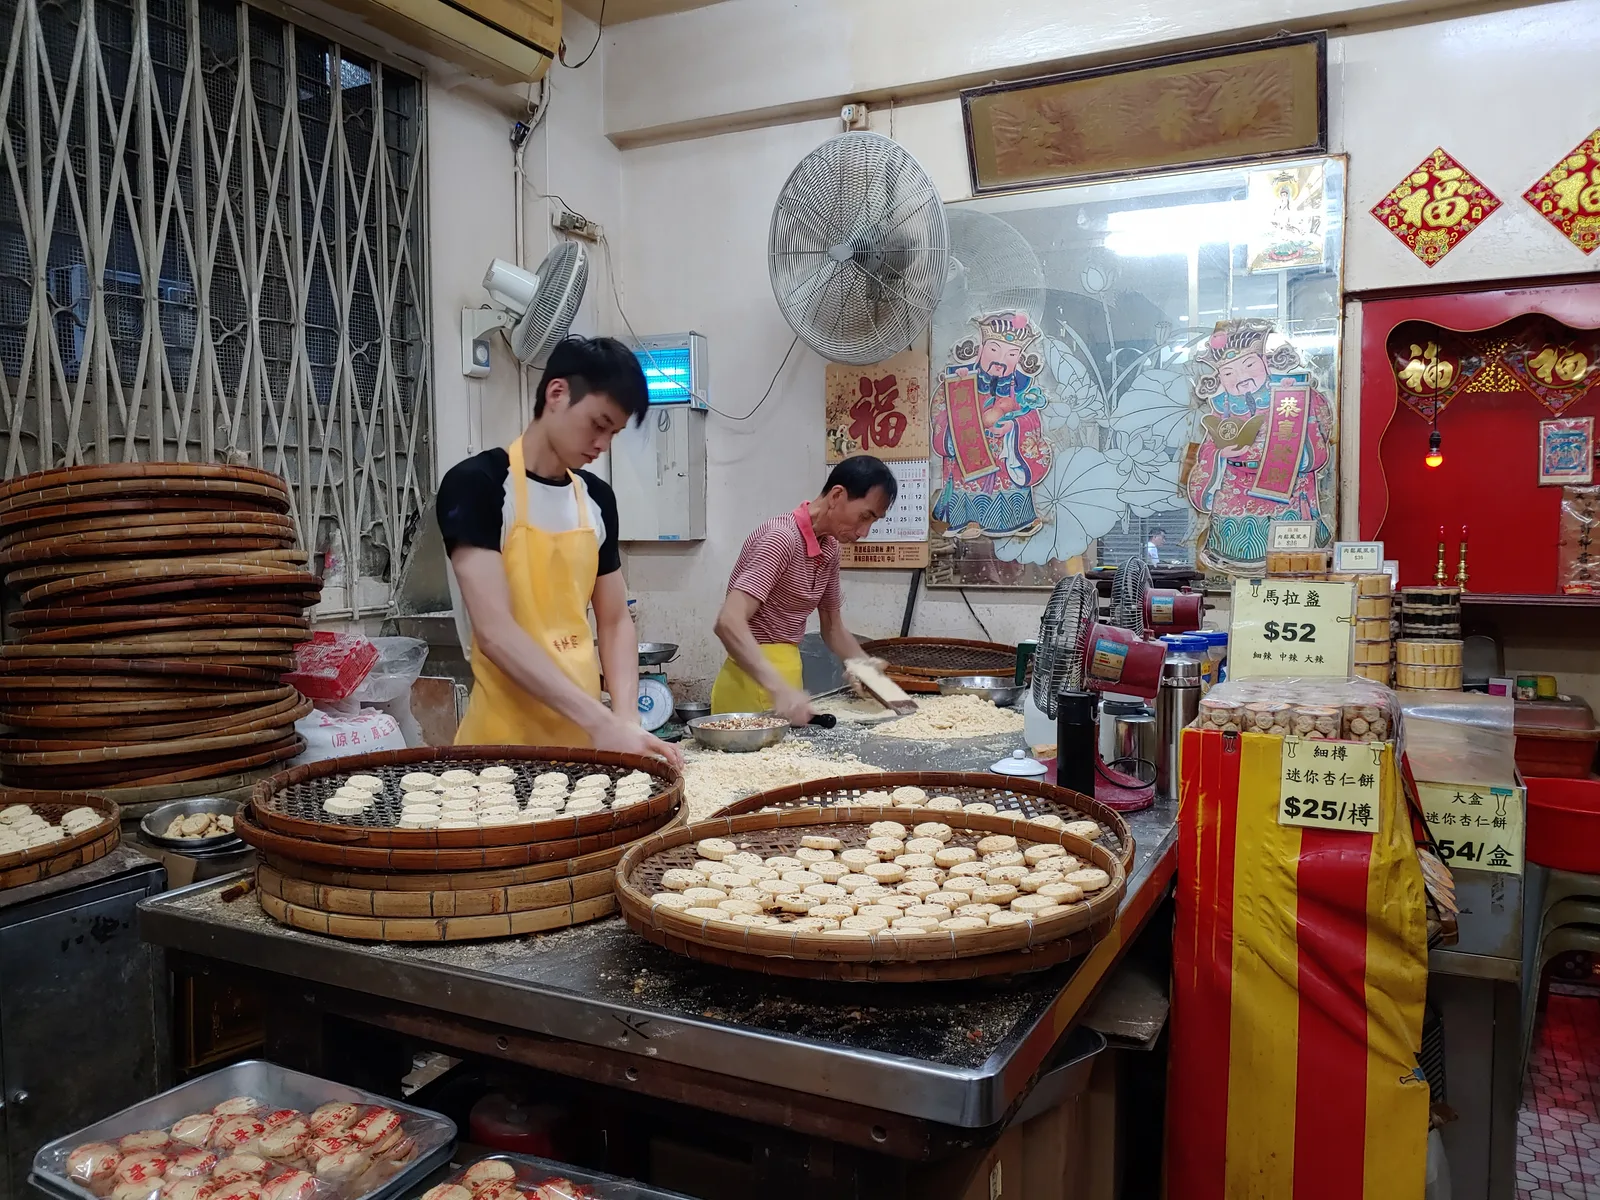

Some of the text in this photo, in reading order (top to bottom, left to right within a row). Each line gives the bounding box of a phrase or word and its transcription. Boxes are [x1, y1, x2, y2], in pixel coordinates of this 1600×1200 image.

[1398, 166, 1470, 228] 福
[1398, 341, 1454, 392] 福
[849, 374, 908, 451] 福
[1265, 396, 1302, 487] 恭喜發財
[1263, 589, 1321, 608] 馬拉盞
[1263, 620, 1316, 643] $52
[1252, 651, 1325, 664] 細辣 中辣 大辣
[1313, 745, 1349, 762] 細樽
[1286, 768, 1375, 789] 迷你杏仁餅
[1451, 792, 1484, 806] 大盒
[1284, 796, 1374, 827] $25/樽
[1426, 811, 1507, 830] 迷你杏仁餅
[1431, 839, 1515, 868] 54/盒
